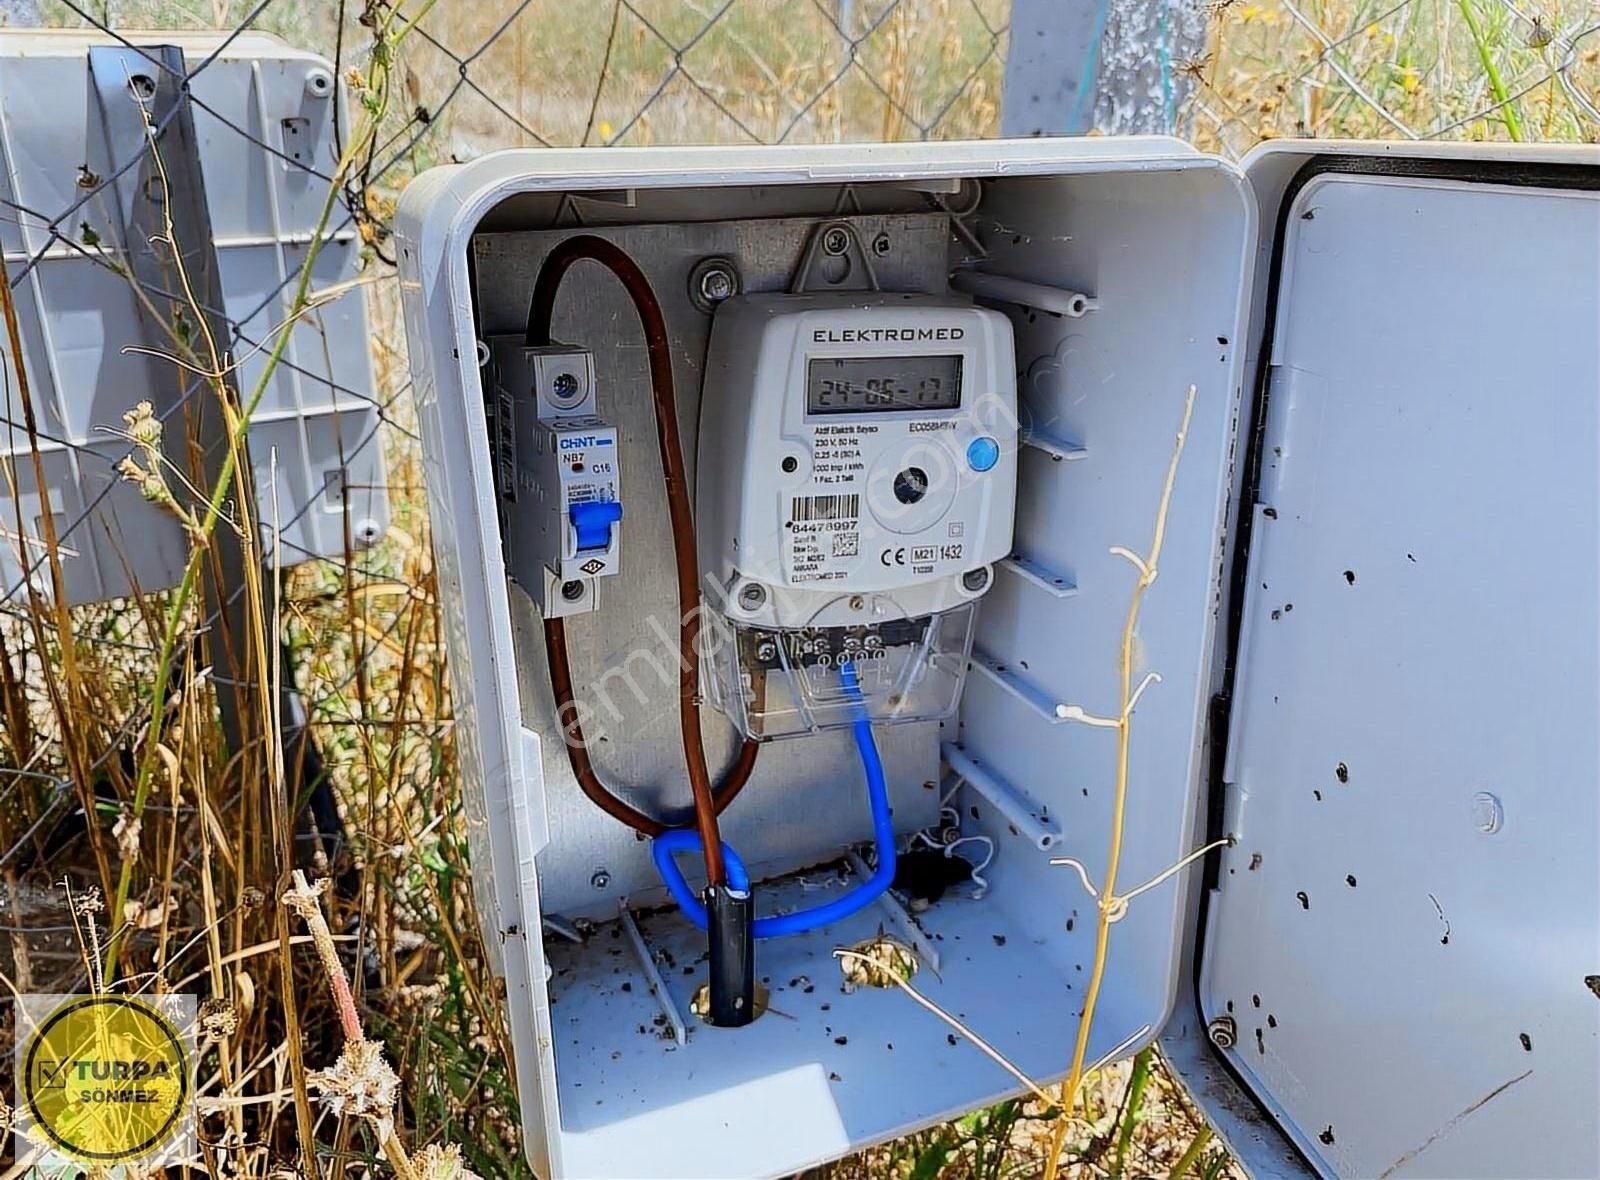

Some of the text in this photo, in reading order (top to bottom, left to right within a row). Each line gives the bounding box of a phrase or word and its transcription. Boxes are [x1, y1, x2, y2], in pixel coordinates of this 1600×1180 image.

[813, 328, 965, 343] ELEKTROMED
[563, 452, 585, 463] NB7
[914, 548, 934, 561] M21
[940, 543, 963, 561] 1432
